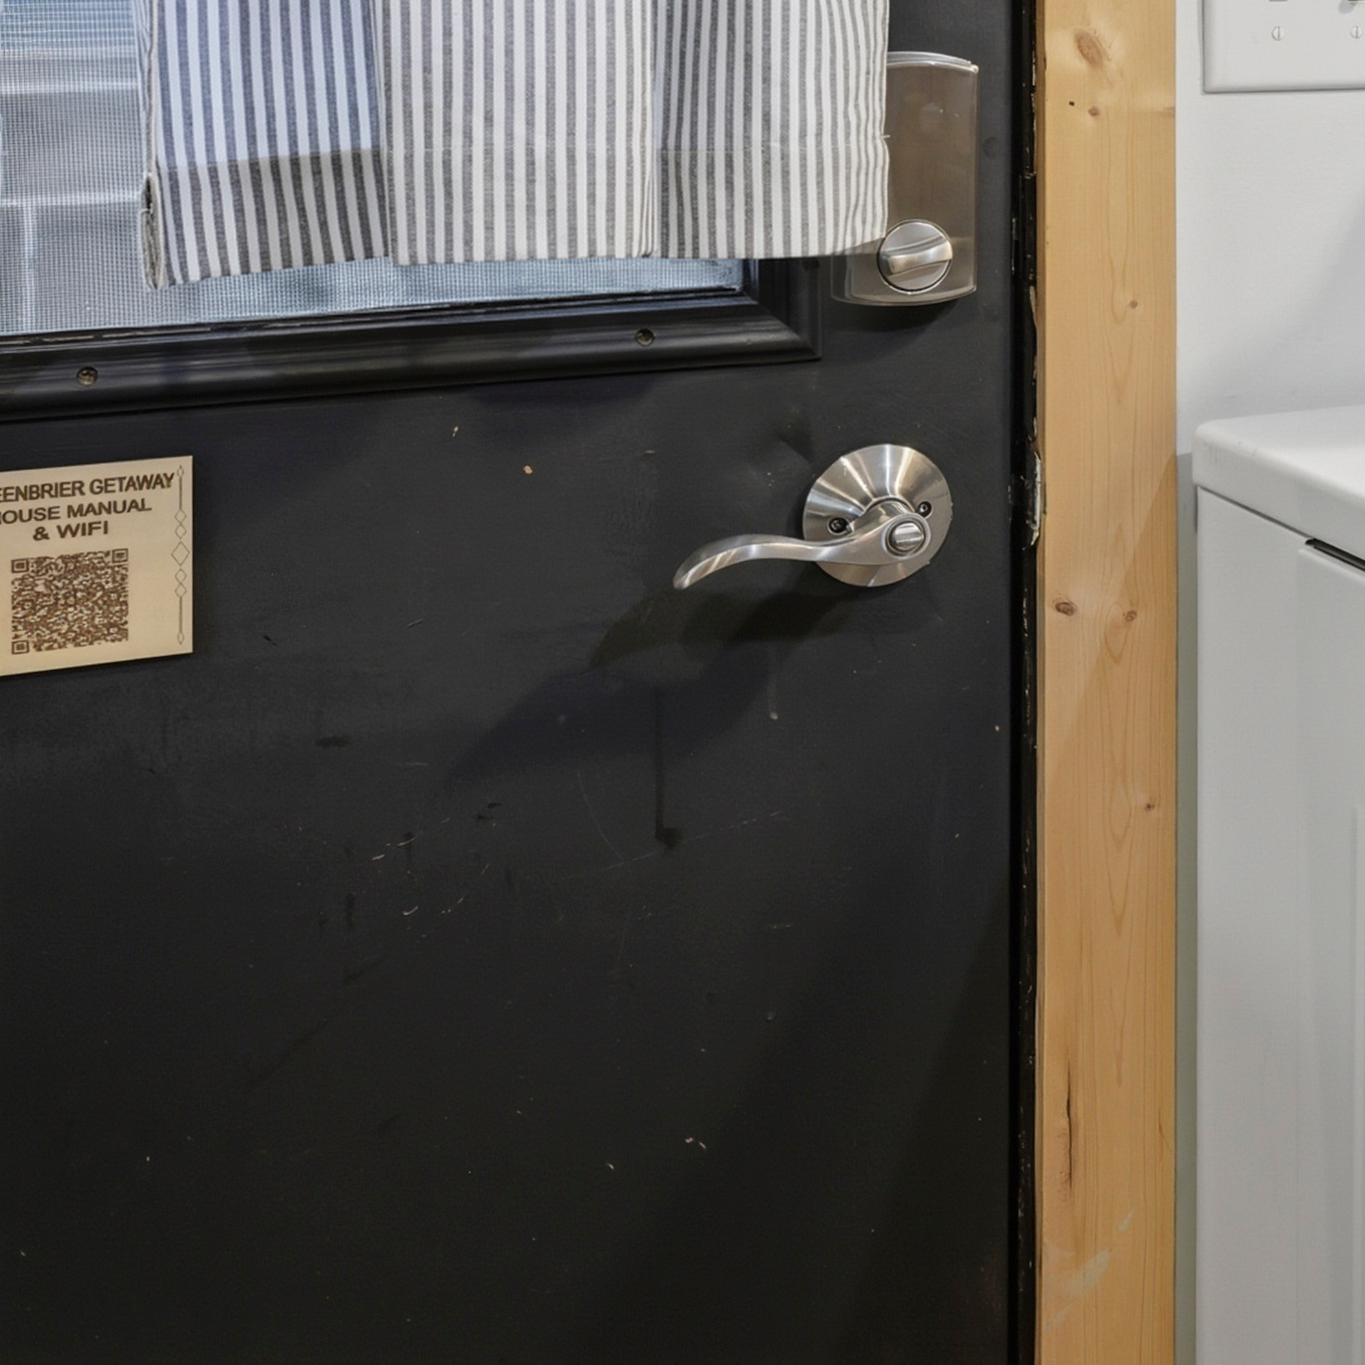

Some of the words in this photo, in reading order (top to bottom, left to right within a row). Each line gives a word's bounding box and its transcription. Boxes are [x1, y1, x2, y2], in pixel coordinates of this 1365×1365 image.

[0, 479, 85, 503] ENBRIER
[89, 472, 175, 495] GETAWAY
[0, 505, 61, 526] OUSE
[67, 498, 152, 519] MANUAL
[33, 526, 50, 541] &
[56, 520, 109, 539] WIFI
